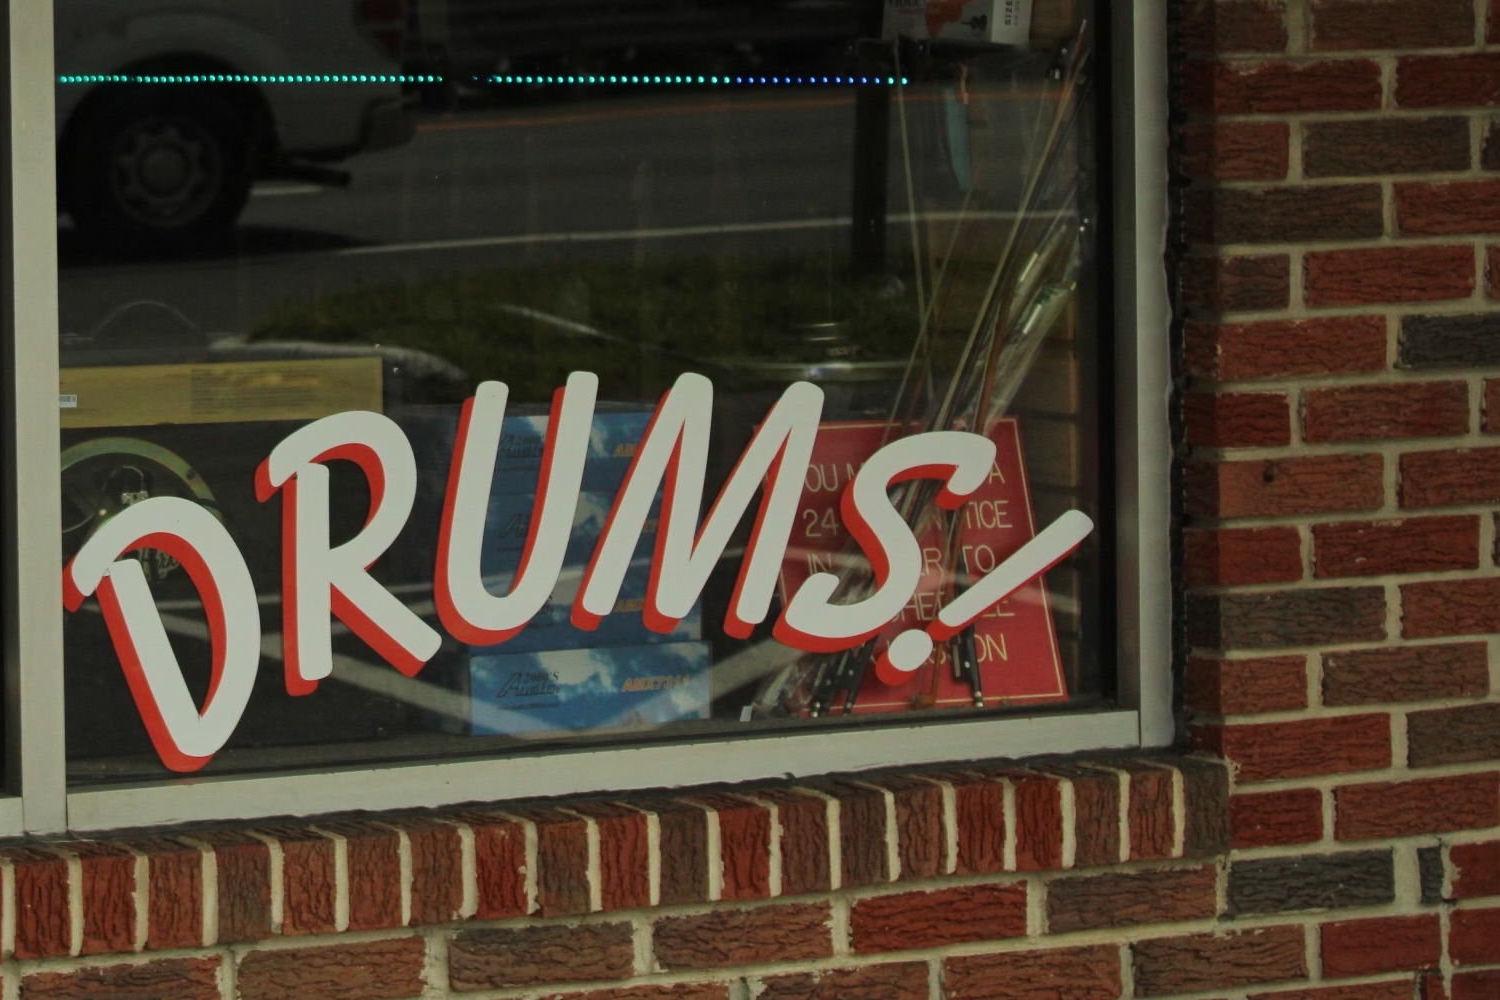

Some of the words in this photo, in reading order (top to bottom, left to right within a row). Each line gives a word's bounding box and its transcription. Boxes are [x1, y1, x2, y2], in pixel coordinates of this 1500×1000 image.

[804, 464, 839, 493] OU
[803, 506, 839, 537] 24
[934, 498, 1014, 530] TICE
[63, 371, 1094, 772] DRUMS!
[807, 552, 832, 576] IN
[961, 544, 996, 574] TO
